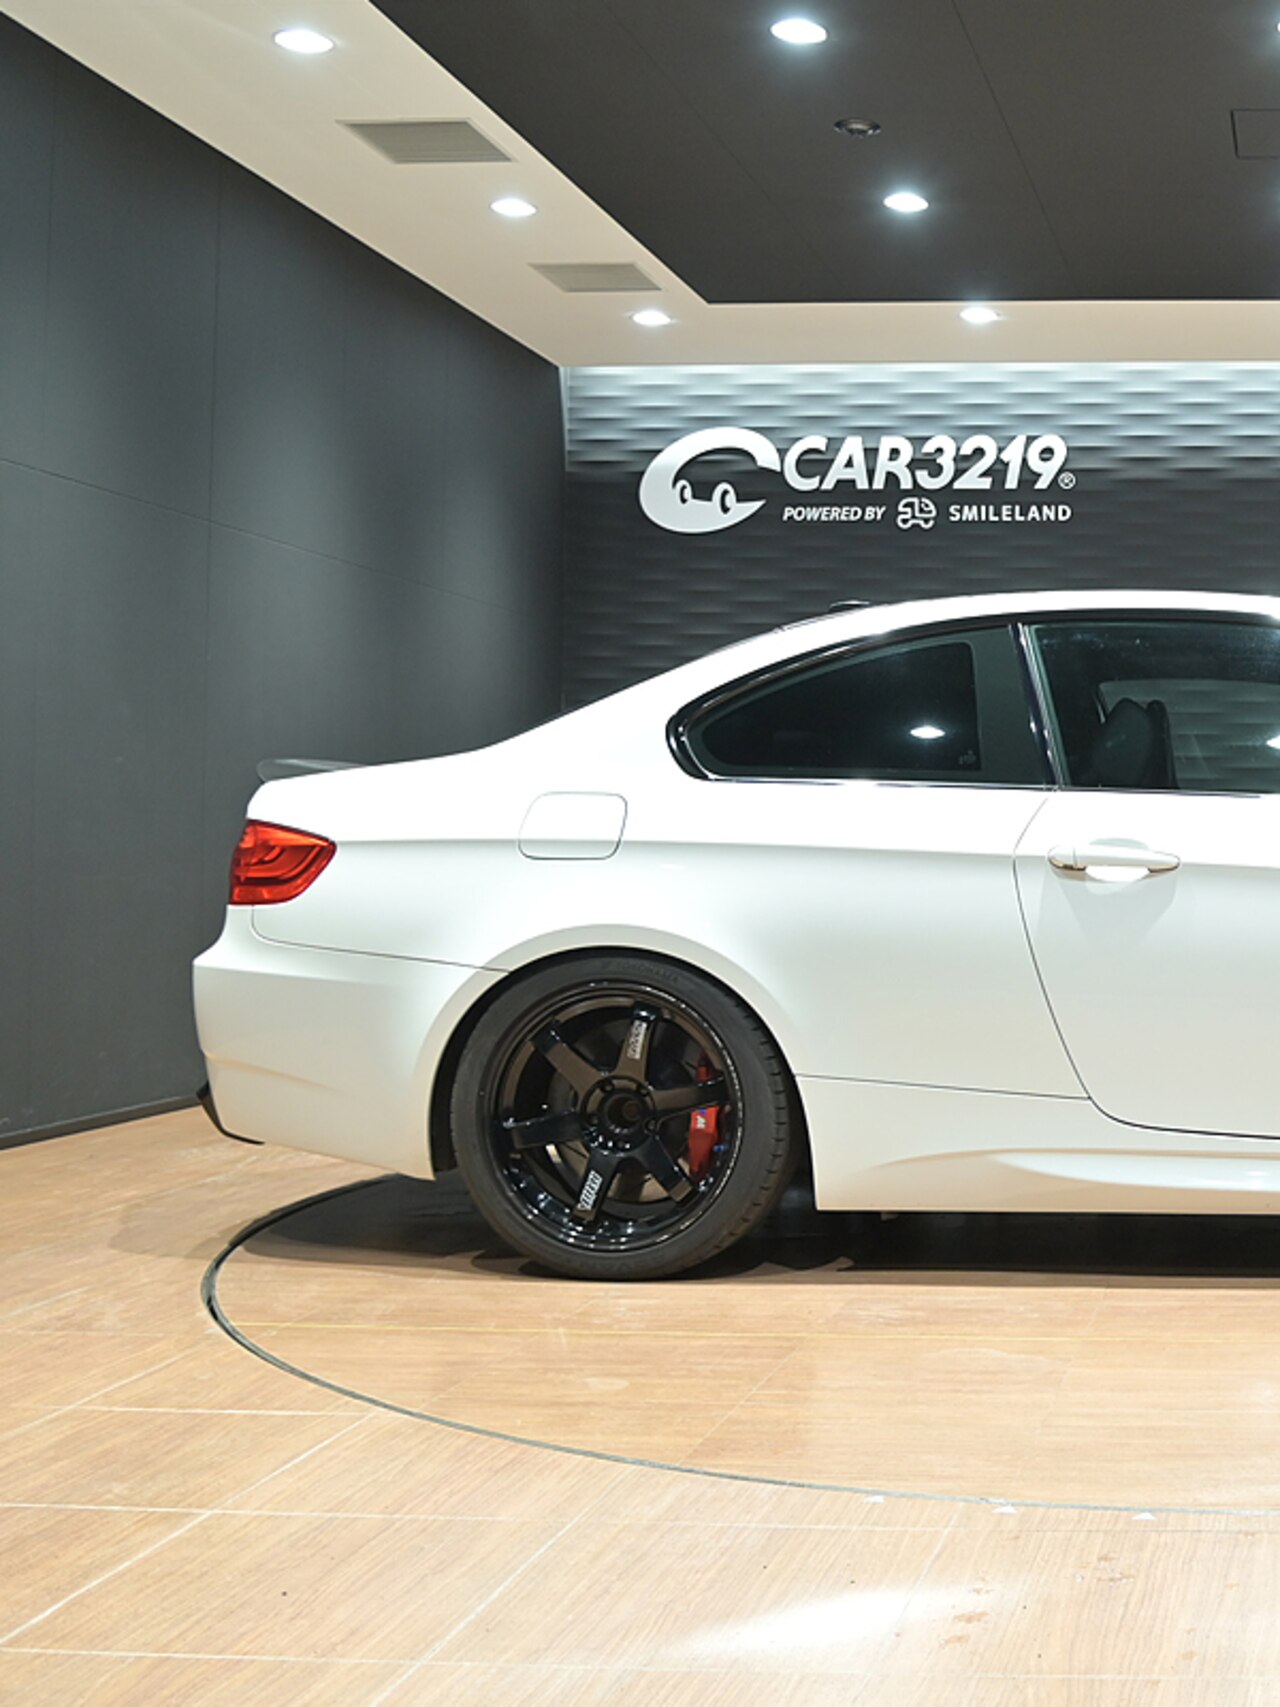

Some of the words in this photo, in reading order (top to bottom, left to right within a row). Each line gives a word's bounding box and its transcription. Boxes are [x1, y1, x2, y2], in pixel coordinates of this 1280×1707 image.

[782, 505, 864, 522] POWERED
[863, 505, 887, 522] BY
[948, 504, 1073, 522] SMILELAND
